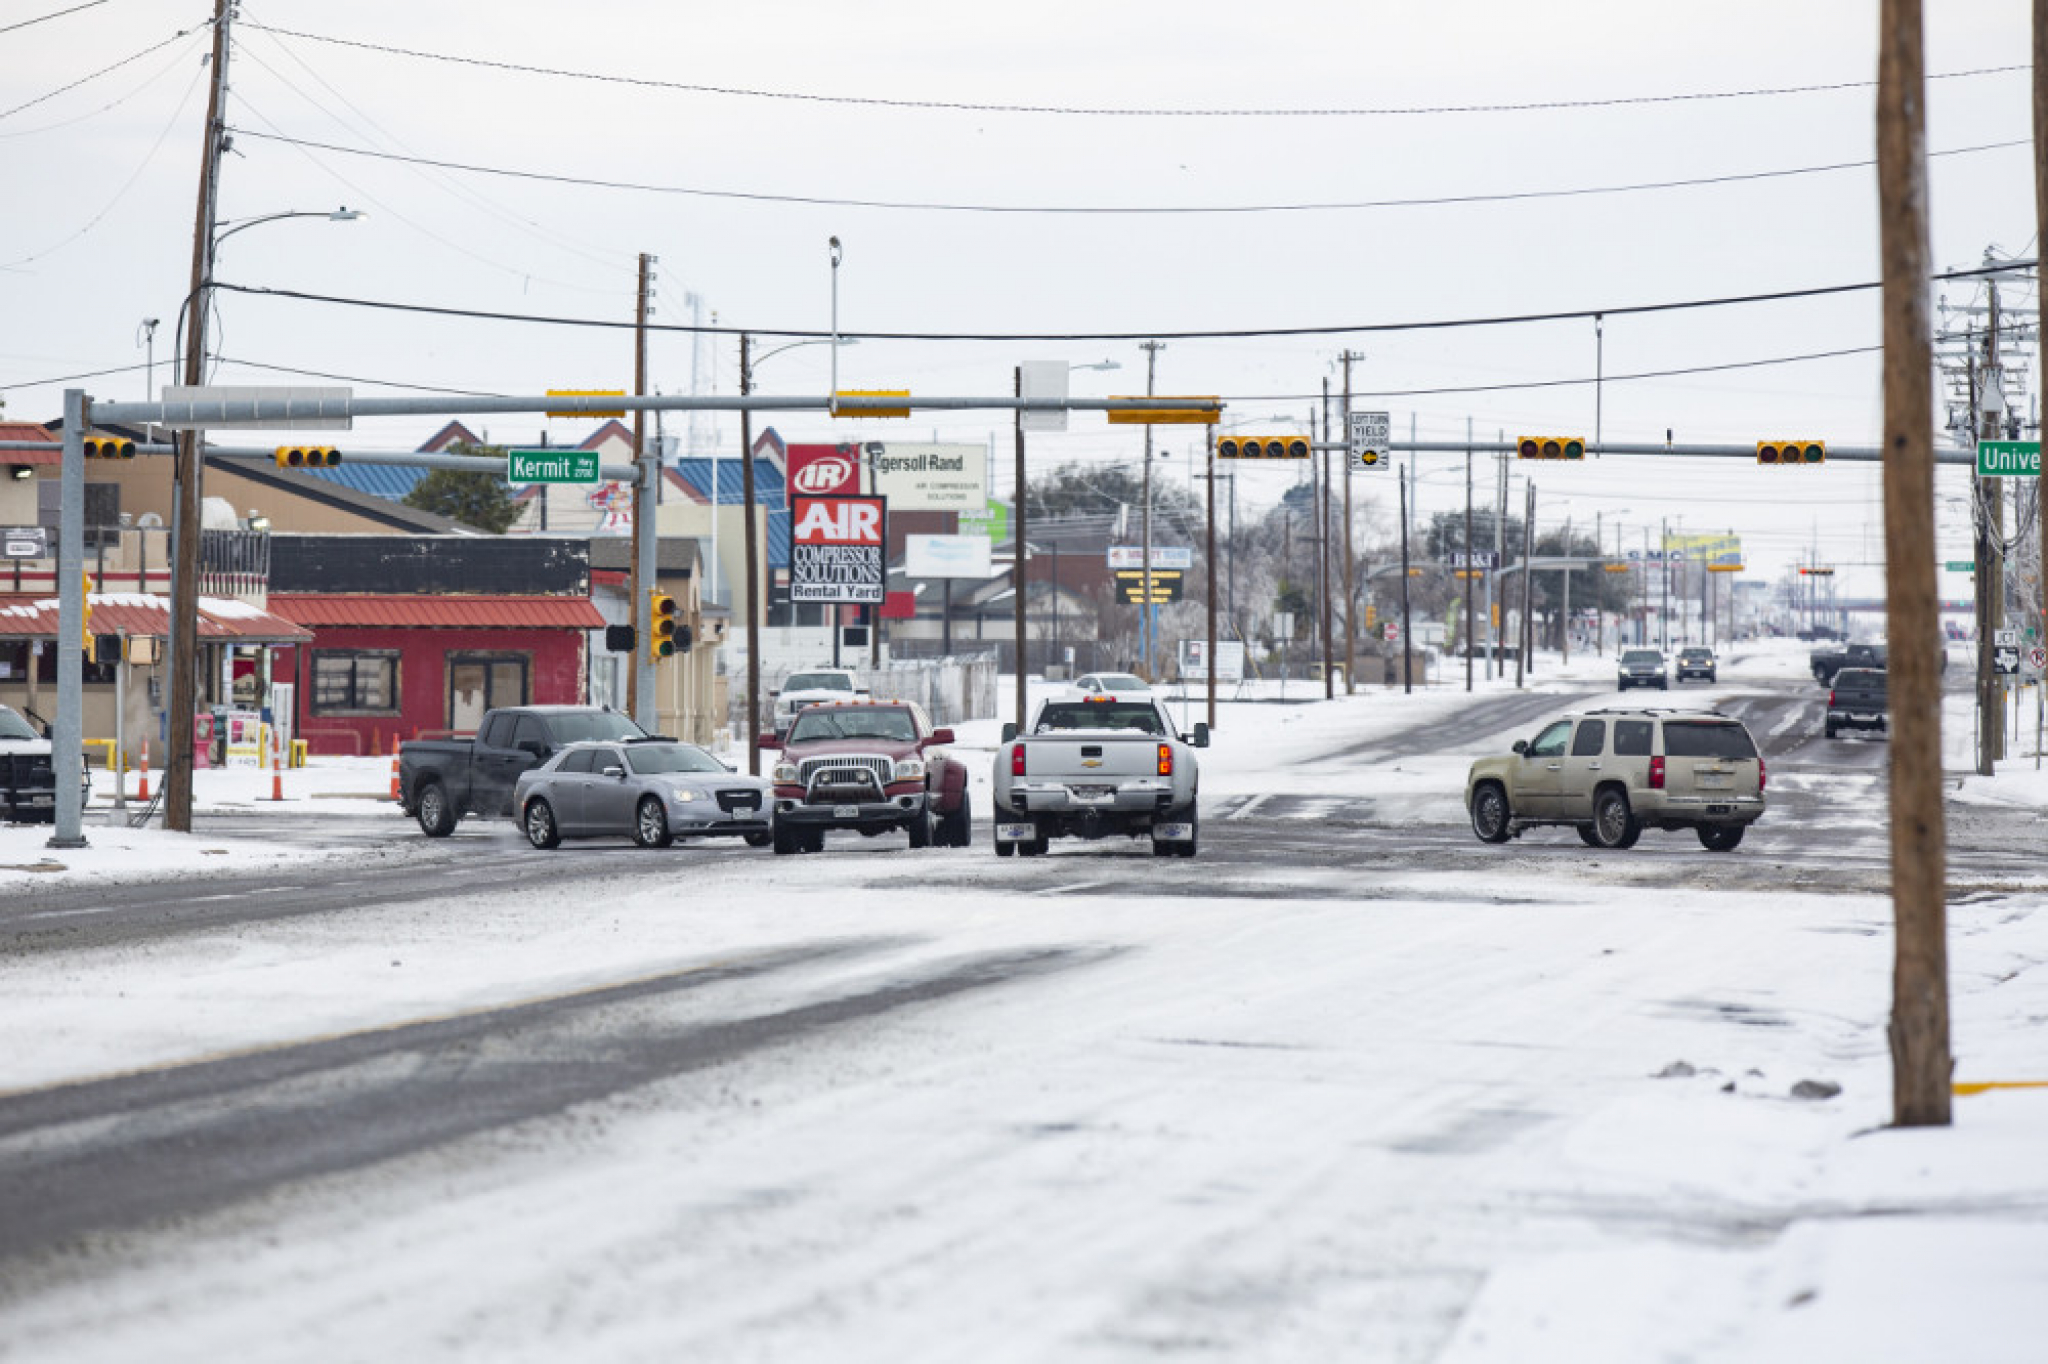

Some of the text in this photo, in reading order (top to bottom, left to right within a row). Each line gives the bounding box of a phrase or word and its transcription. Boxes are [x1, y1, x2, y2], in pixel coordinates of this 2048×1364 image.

[1352, 415, 1388, 425] LEFT TURN
[1353, 426, 1387, 437] YIELD
[514, 456, 571, 478] Kermit
[804, 464, 842, 488] IR
[795, 502, 881, 541] AIR
[794, 545, 881, 564] COMPRESSOR
[794, 563, 881, 583] SOLUTIONS
[794, 585, 880, 599] Rental Yard
